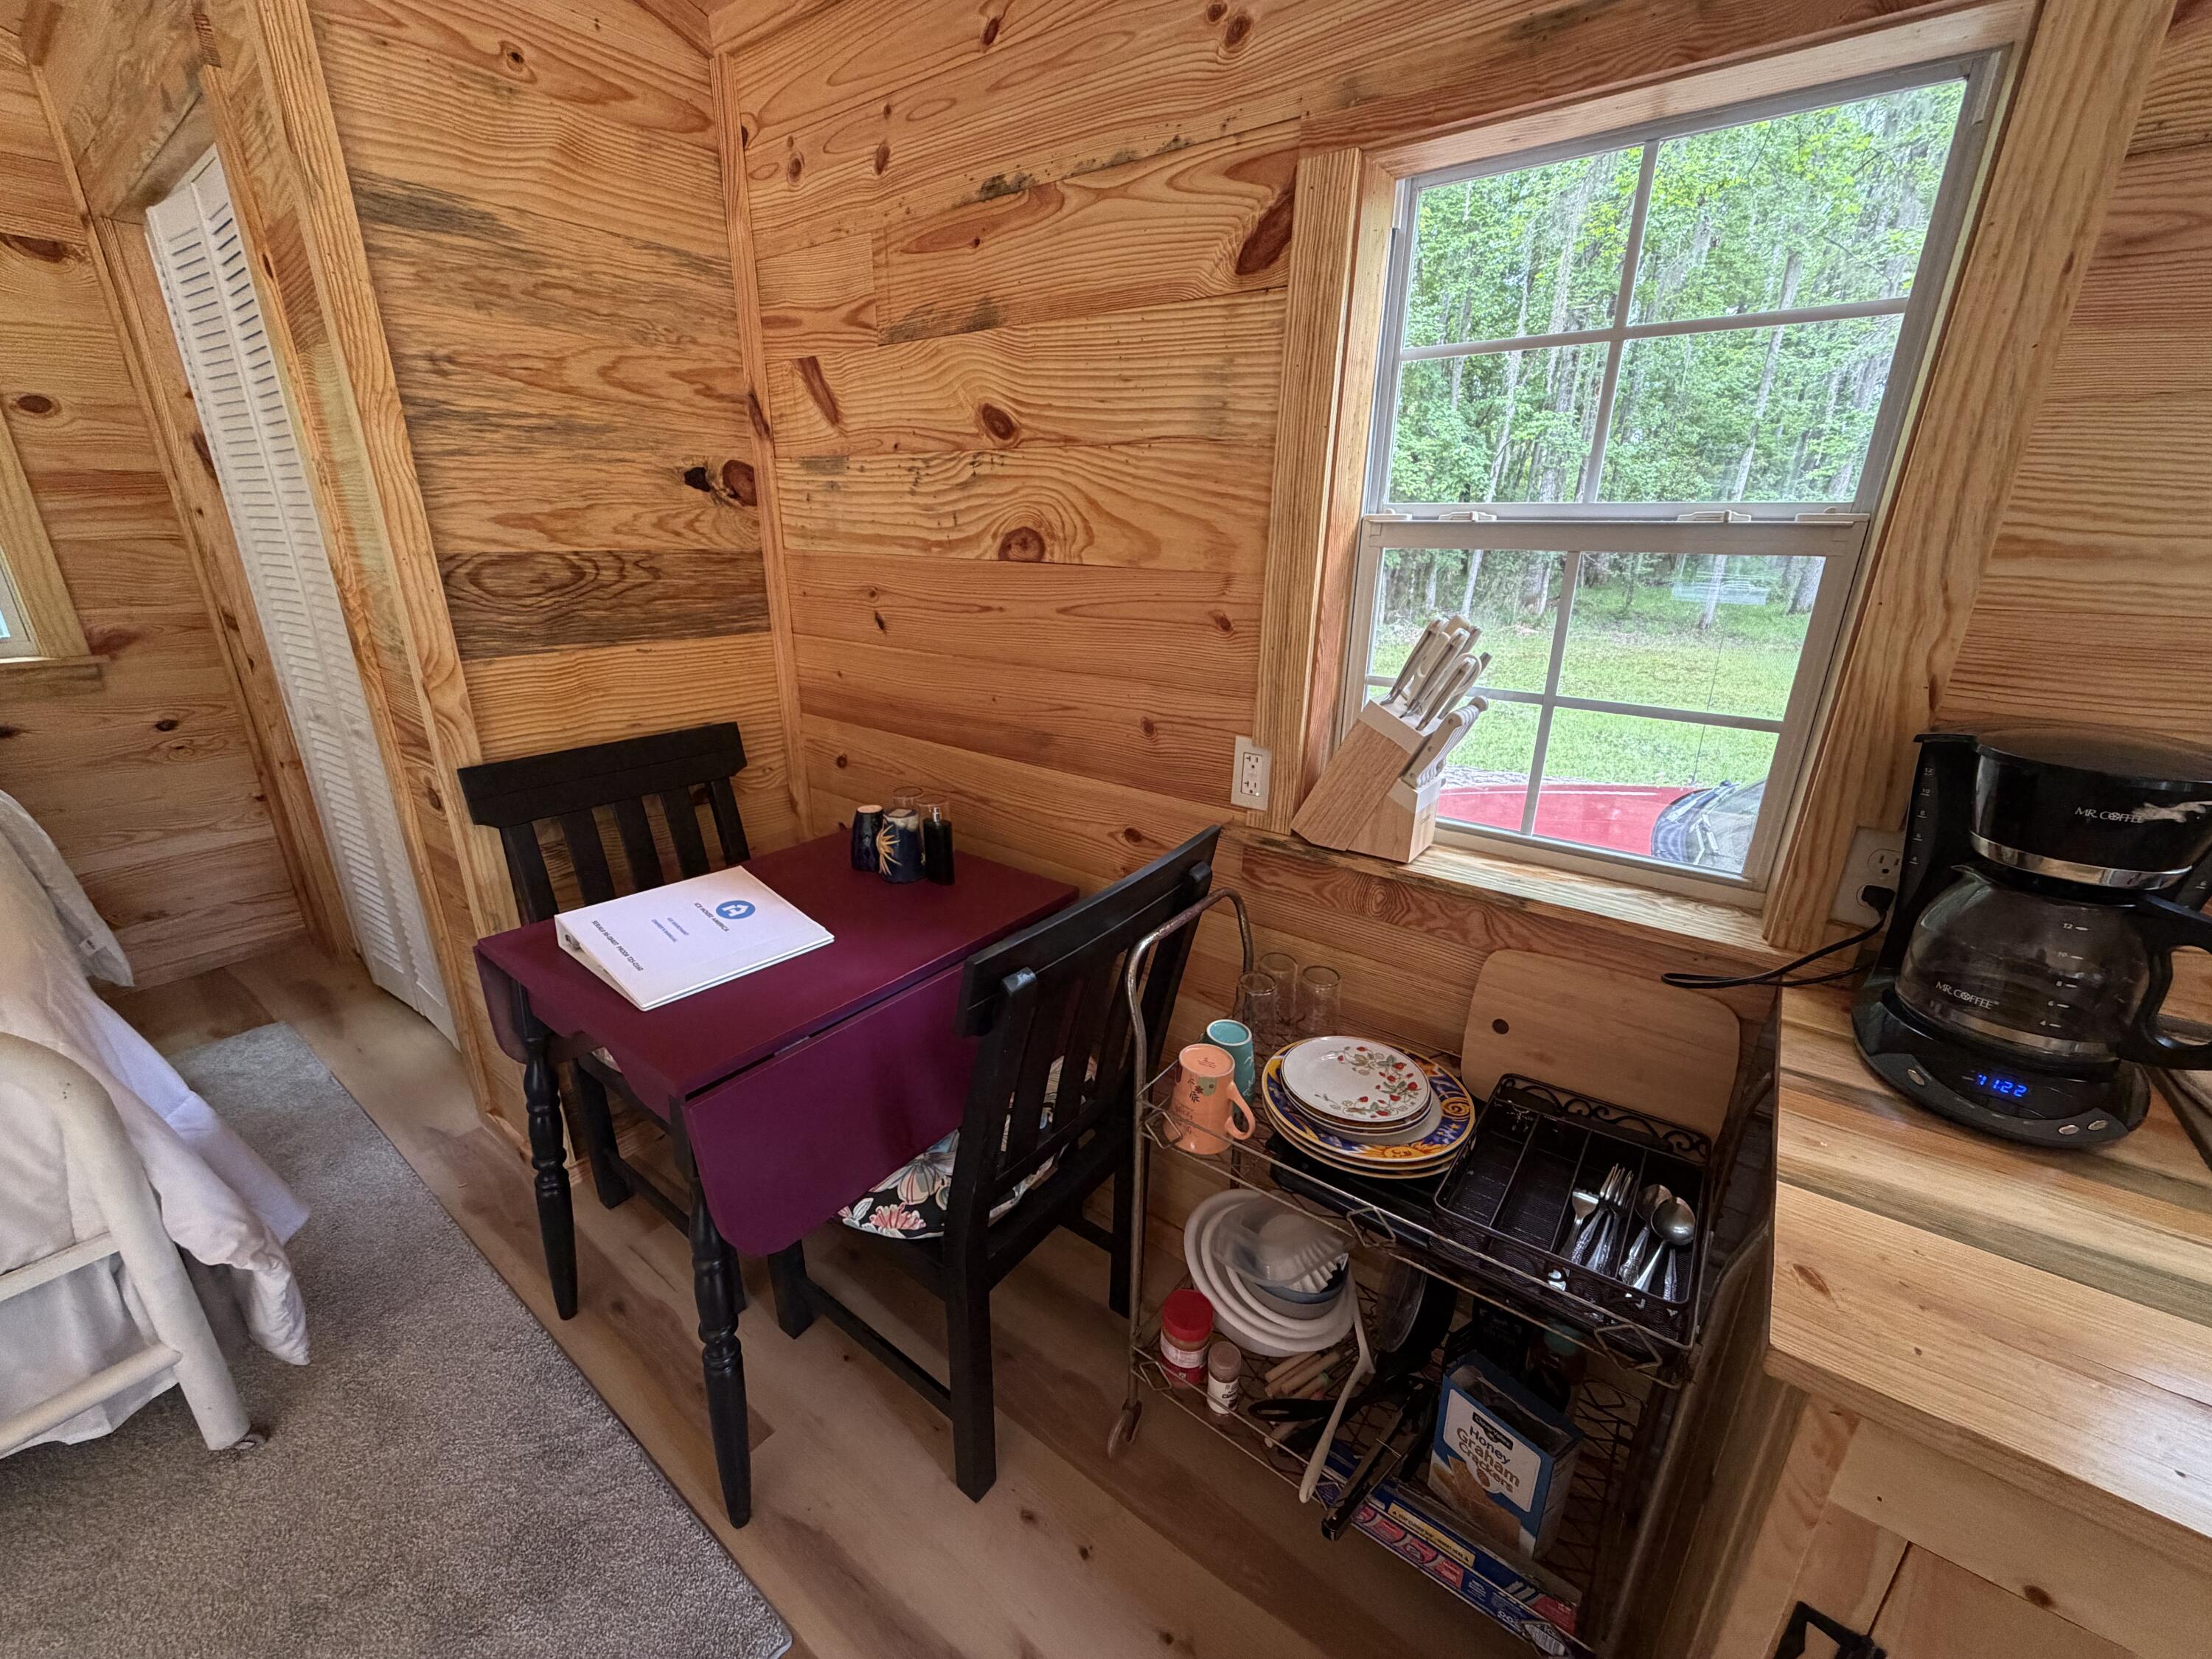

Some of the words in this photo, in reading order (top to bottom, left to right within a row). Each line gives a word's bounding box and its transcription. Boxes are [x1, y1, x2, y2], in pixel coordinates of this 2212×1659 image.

[1953, 989, 1993, 1010] COFFEE
[1456, 1427, 1520, 1487] Graham
[1458, 1441, 1514, 1493] Crackers
[1470, 1425, 1511, 1464] Honey
